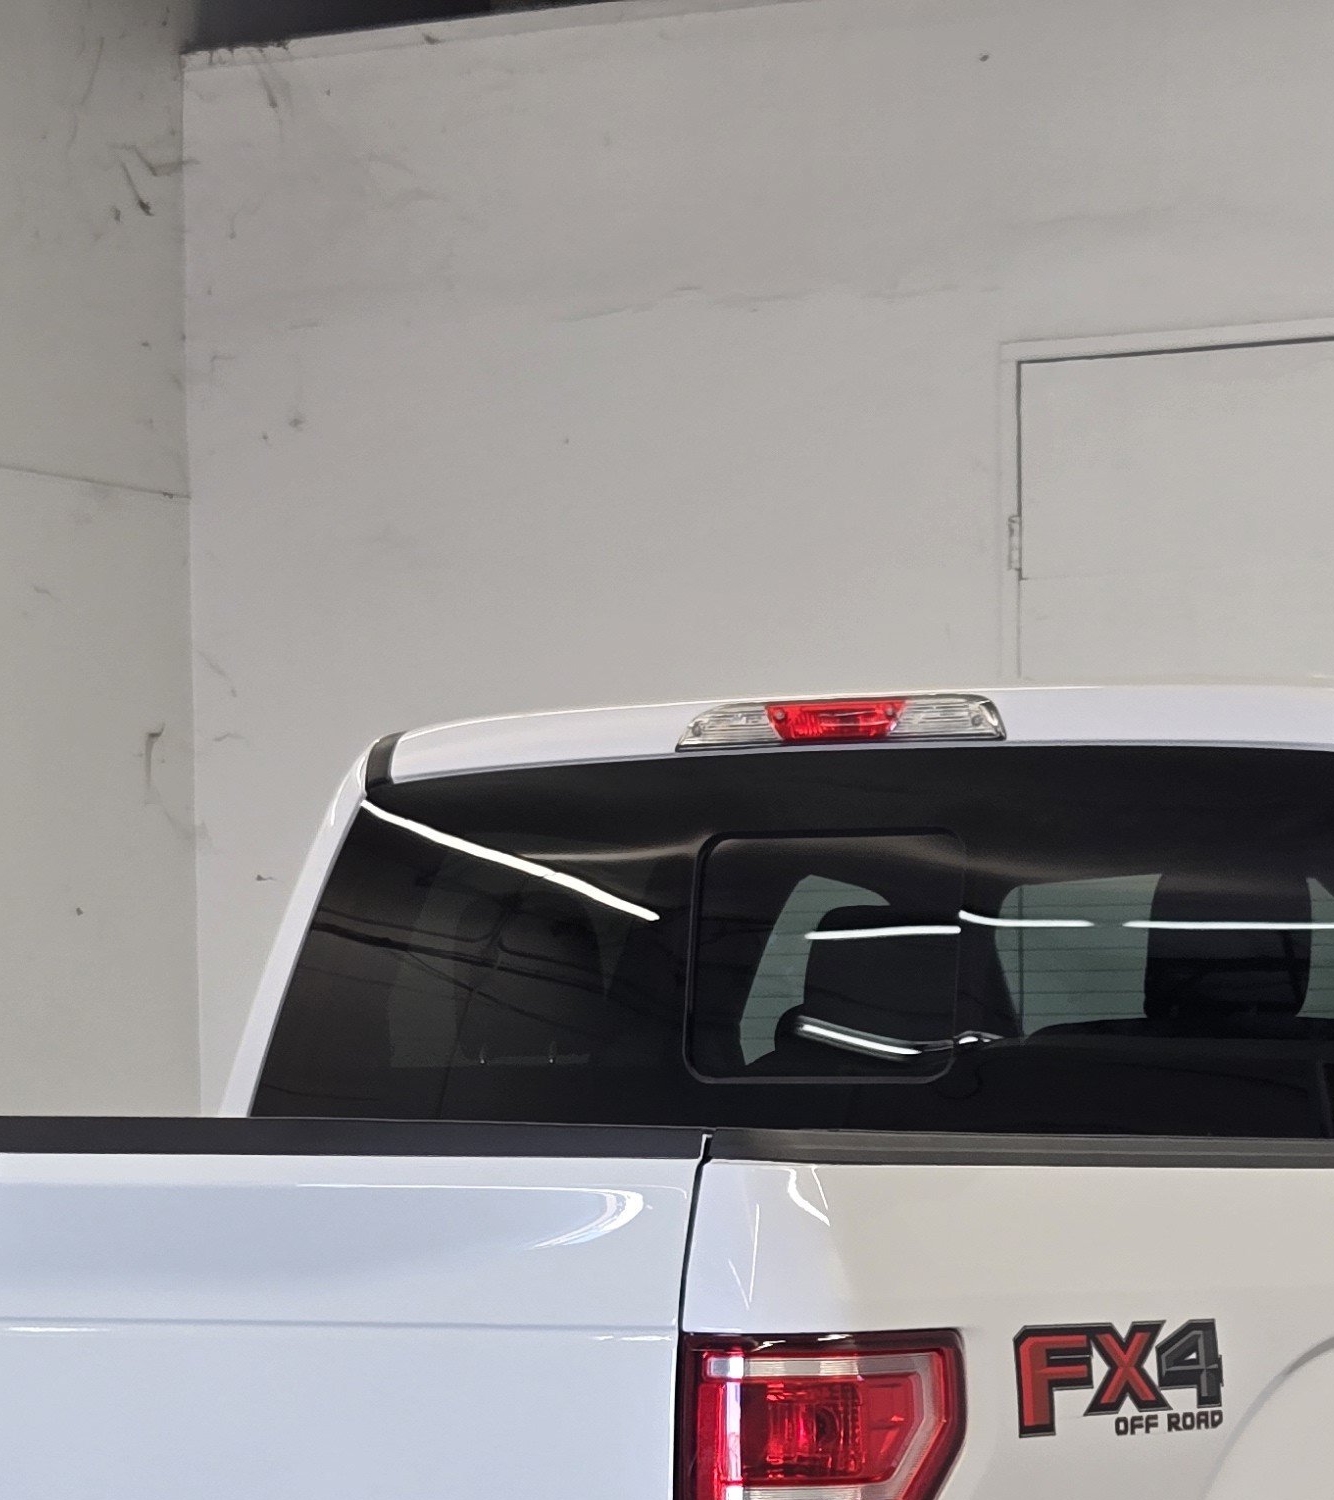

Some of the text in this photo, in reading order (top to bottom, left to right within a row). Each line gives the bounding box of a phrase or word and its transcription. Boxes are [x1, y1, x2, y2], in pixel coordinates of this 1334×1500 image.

[1013, 1318, 1224, 1438] FX4
[1115, 1409, 1224, 1436] OFF ROAD
